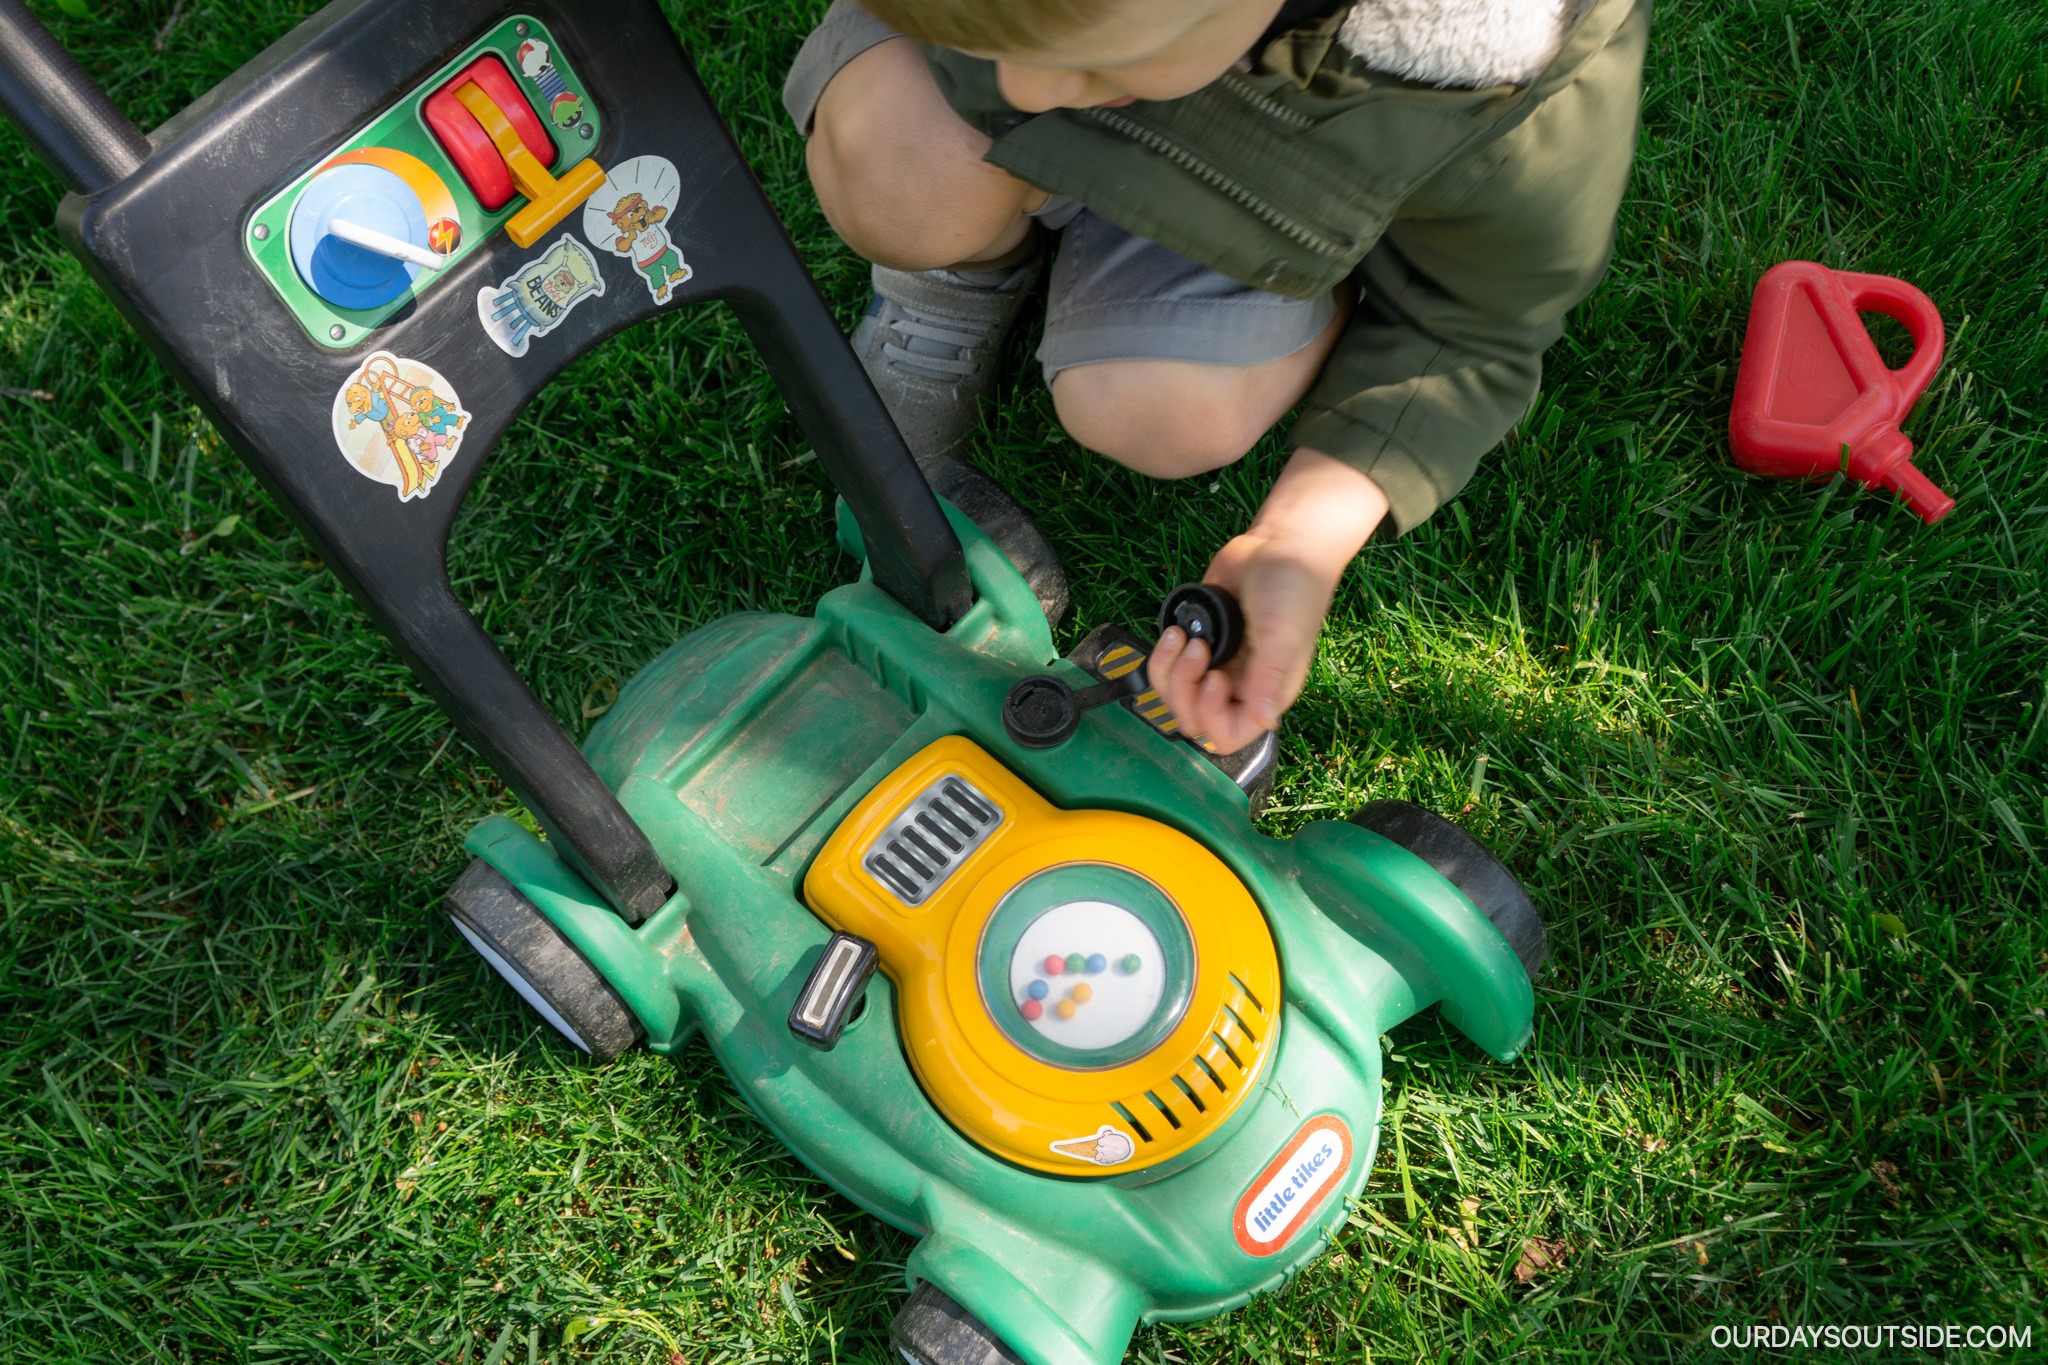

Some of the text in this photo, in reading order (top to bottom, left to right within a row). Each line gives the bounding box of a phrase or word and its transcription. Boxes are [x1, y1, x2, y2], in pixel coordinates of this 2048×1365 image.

[526, 275, 562, 318] BEANS
[1253, 1143, 1333, 1233] little tikes
